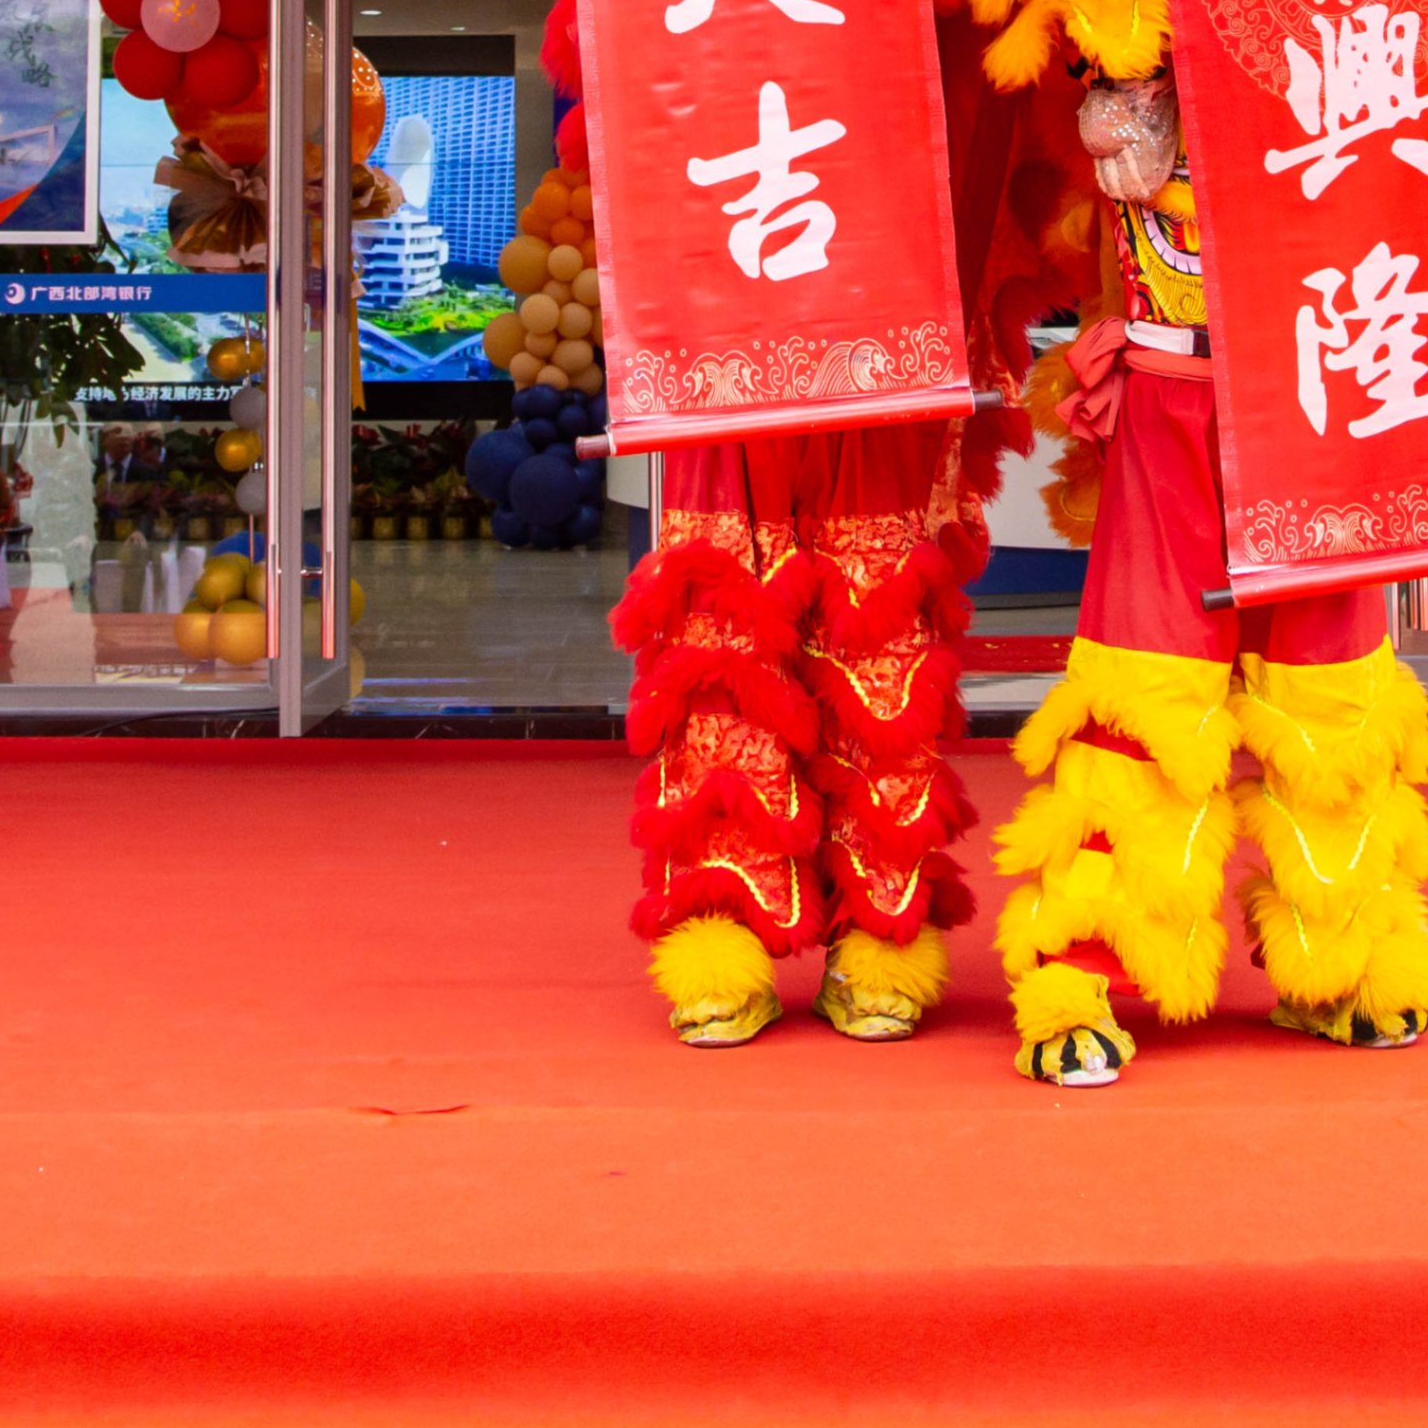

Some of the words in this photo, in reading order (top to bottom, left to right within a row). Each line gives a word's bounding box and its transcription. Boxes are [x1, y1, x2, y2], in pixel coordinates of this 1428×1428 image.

[30, 285, 152, 303] 广西北部湾银行
